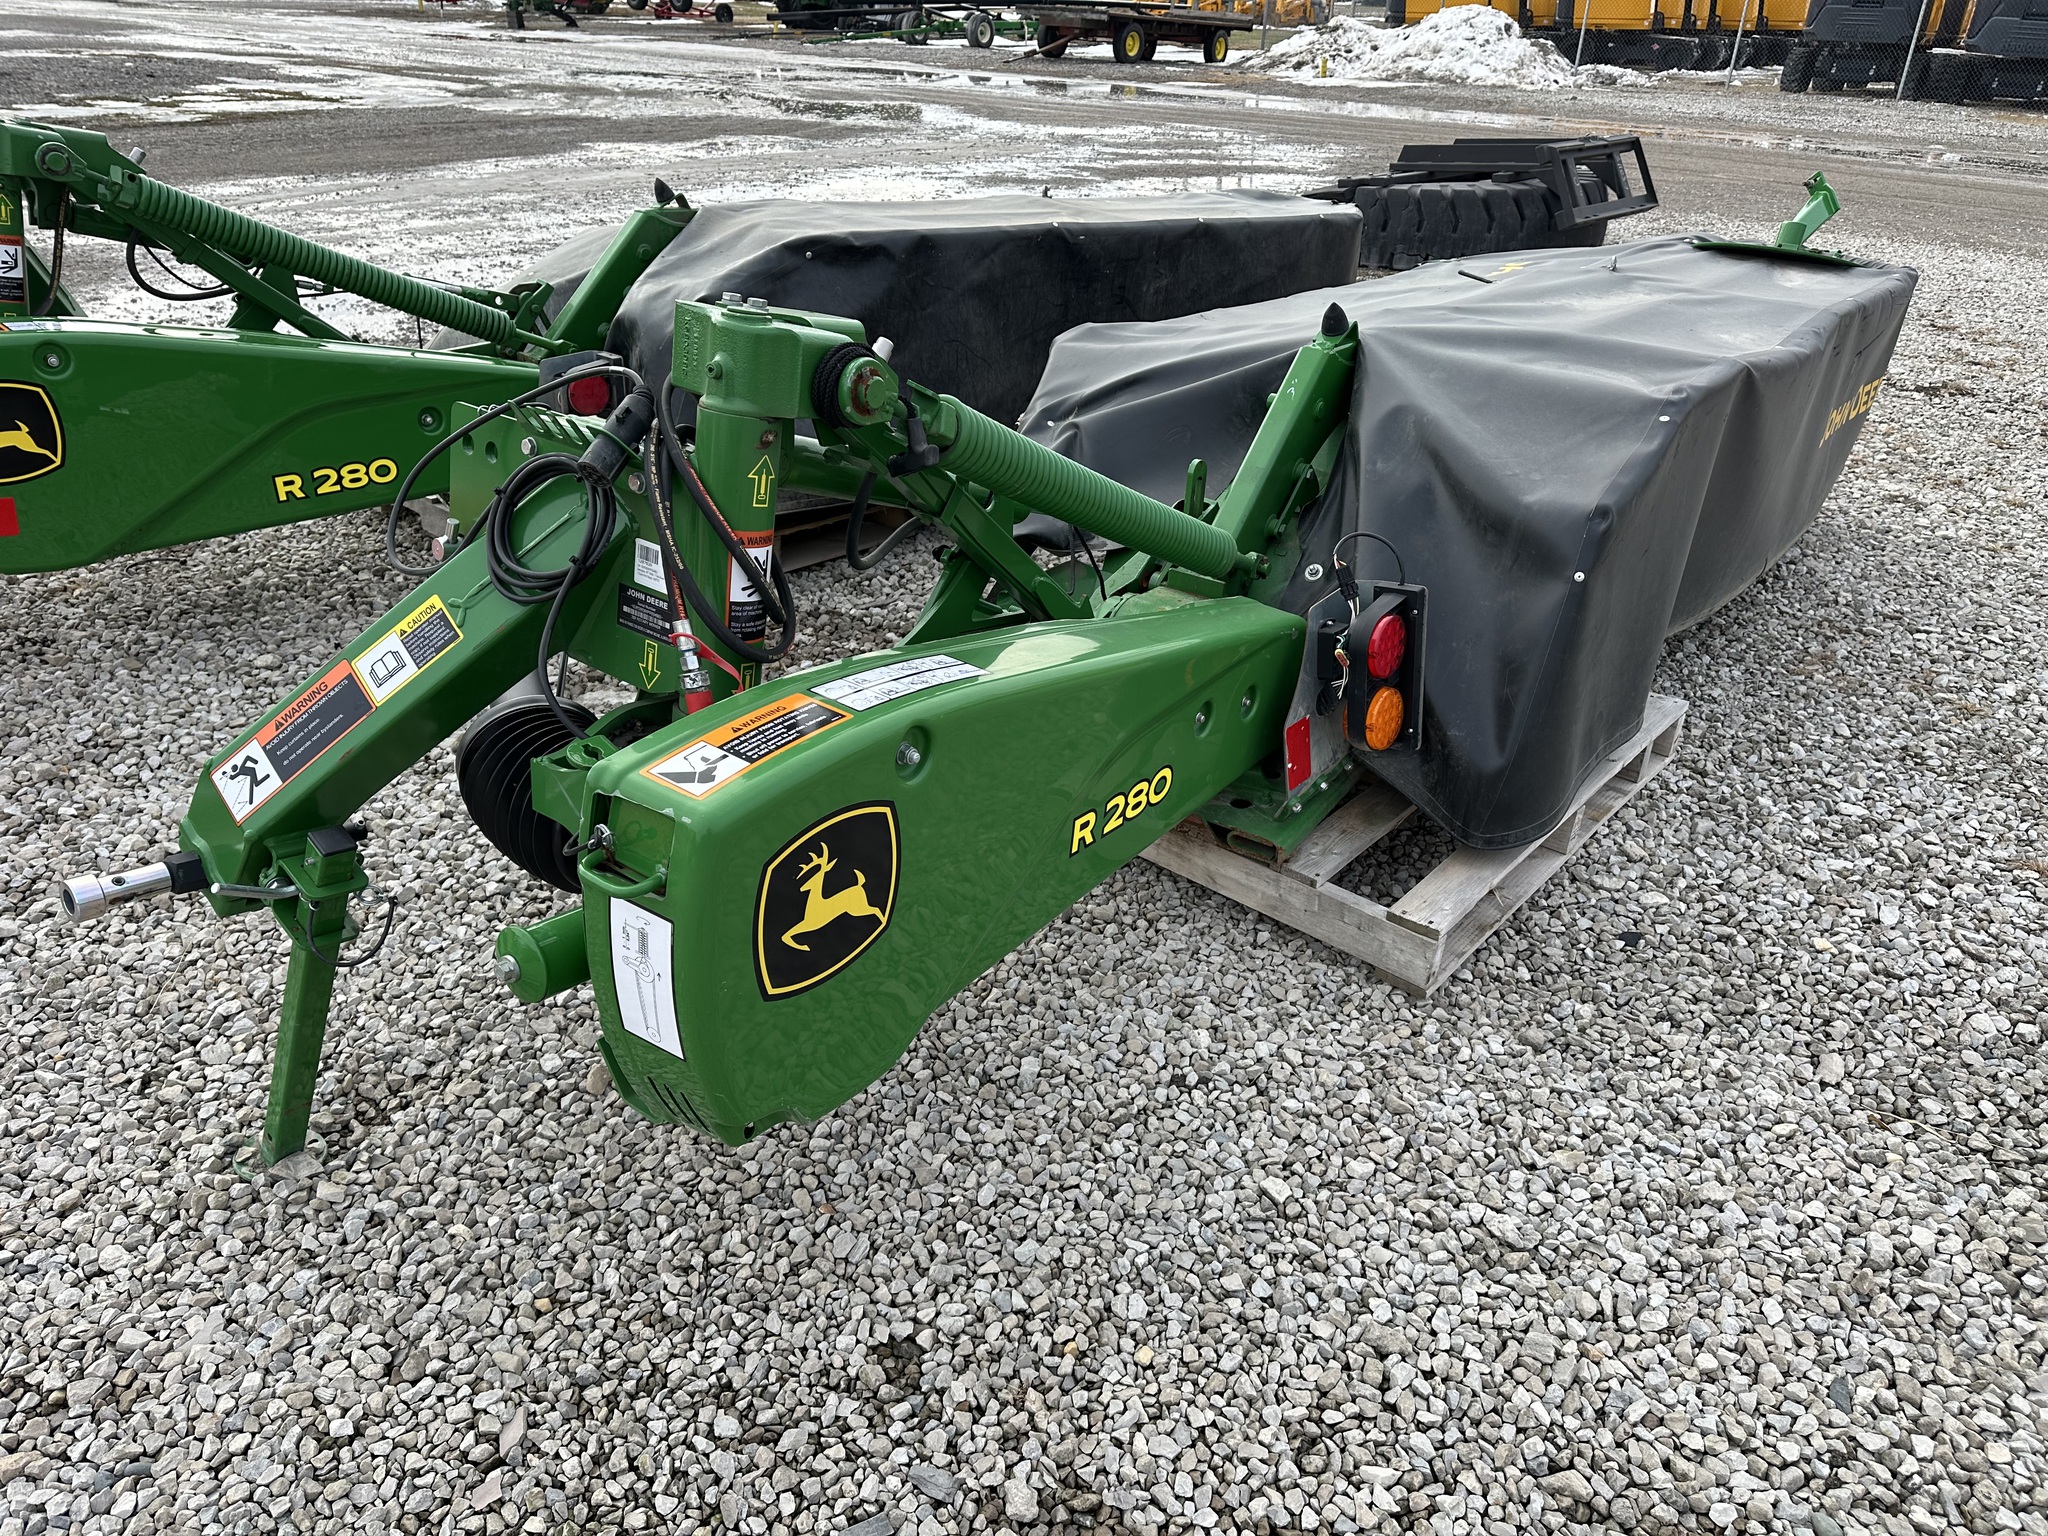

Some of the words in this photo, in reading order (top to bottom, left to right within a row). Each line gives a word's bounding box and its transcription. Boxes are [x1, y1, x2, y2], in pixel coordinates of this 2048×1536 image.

[273, 473, 309, 502] R
[311, 457, 398, 496] 280
[627, 589, 645, 600] JOHN
[646, 595, 668, 609] DEERE
[407, 603, 436, 629] CAUTION
[402, 633, 414, 643] Read
[266, 736, 279, 750] AVOID
[279, 723, 294, 738] INJURY
[294, 712, 308, 725] FROM
[307, 696, 328, 714] THROWN
[327, 679, 348, 697] OBJECTS
[281, 682, 327, 722] WARNING
[739, 706, 786, 727] WARNING
[288, 752, 296, 760] not
[295, 740, 311, 754] operate
[311, 732, 321, 741] near
[320, 714, 343, 733] bystanders.
[723, 739, 740, 749] AVOID
[739, 729, 758, 740] INJURY
[758, 722, 774, 731] FROM
[773, 711, 800, 723] ROTATING
[734, 742, 748, 750] Keep
[747, 734, 764, 743] hands
[766, 736, 782, 745] power
[276, 745, 288, 755] Keep
[288, 731, 304, 746] curtains
[740, 740, 761, 753] machine
[1069, 808, 1097, 858] R
[1101, 764, 1173, 838] 280
